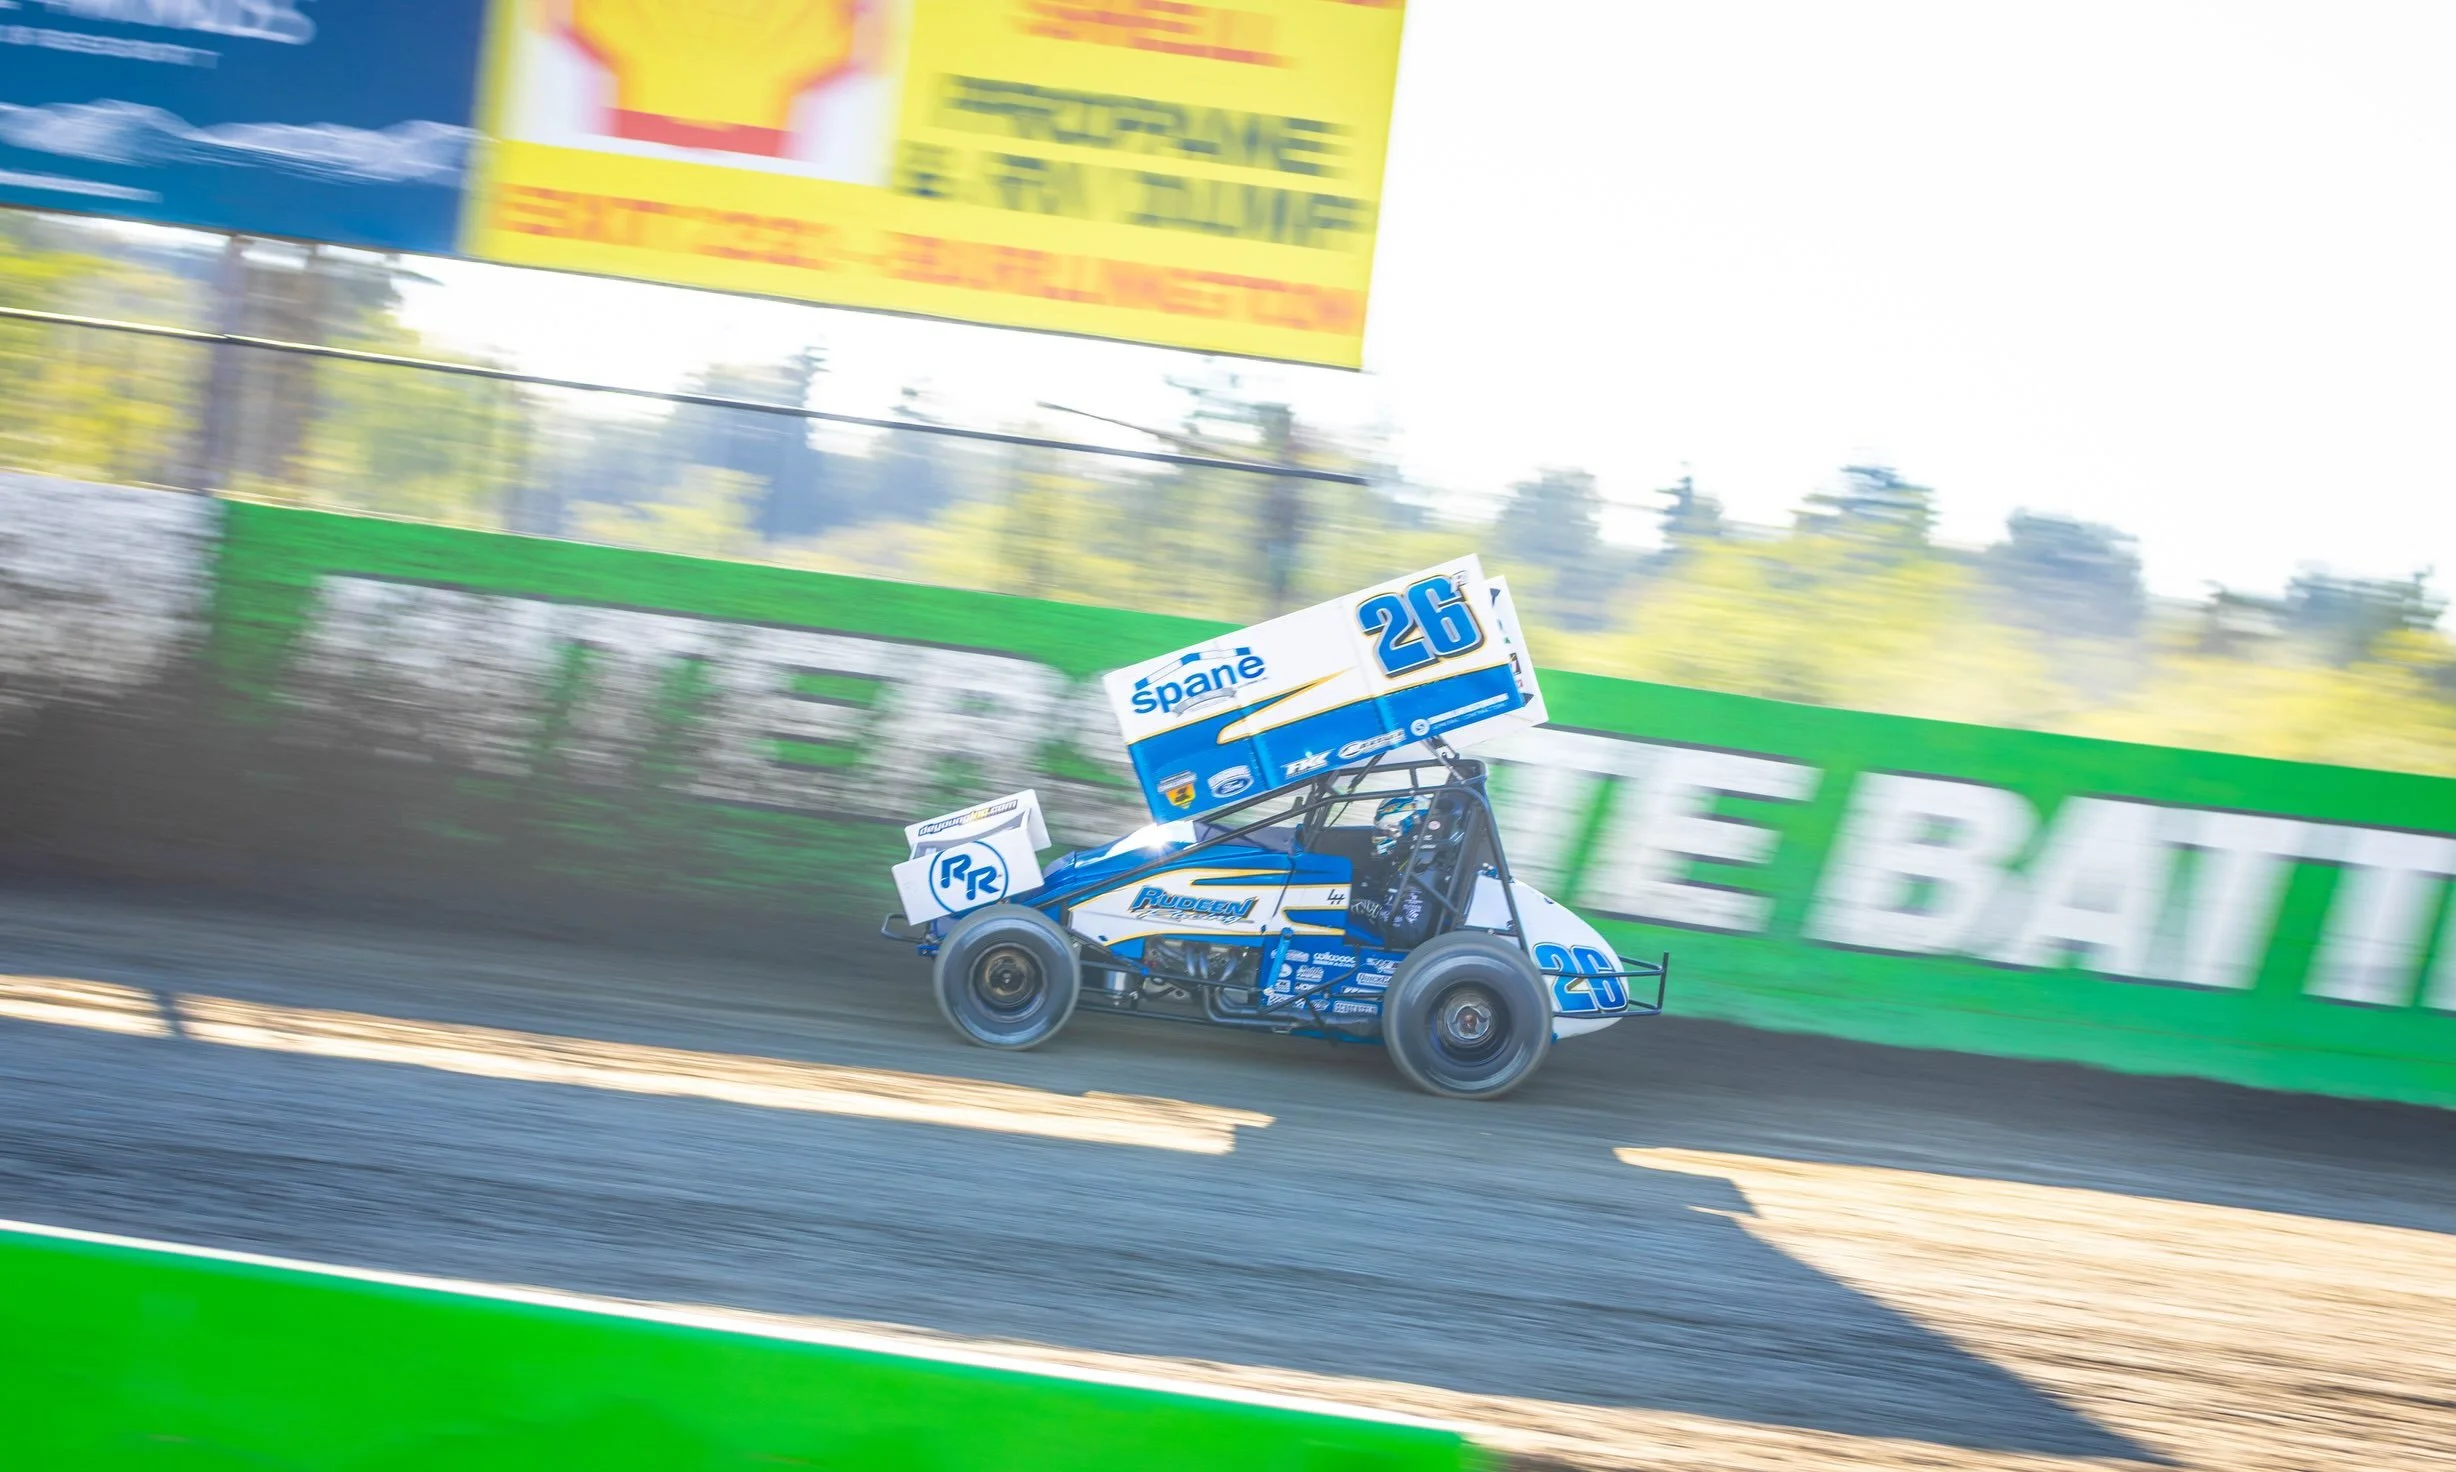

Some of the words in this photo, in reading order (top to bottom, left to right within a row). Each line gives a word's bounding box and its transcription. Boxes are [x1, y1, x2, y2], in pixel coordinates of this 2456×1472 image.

[1357, 573, 1485, 679] 26
[1131, 653, 1265, 716] spane
[1531, 943, 1628, 1012] 26
